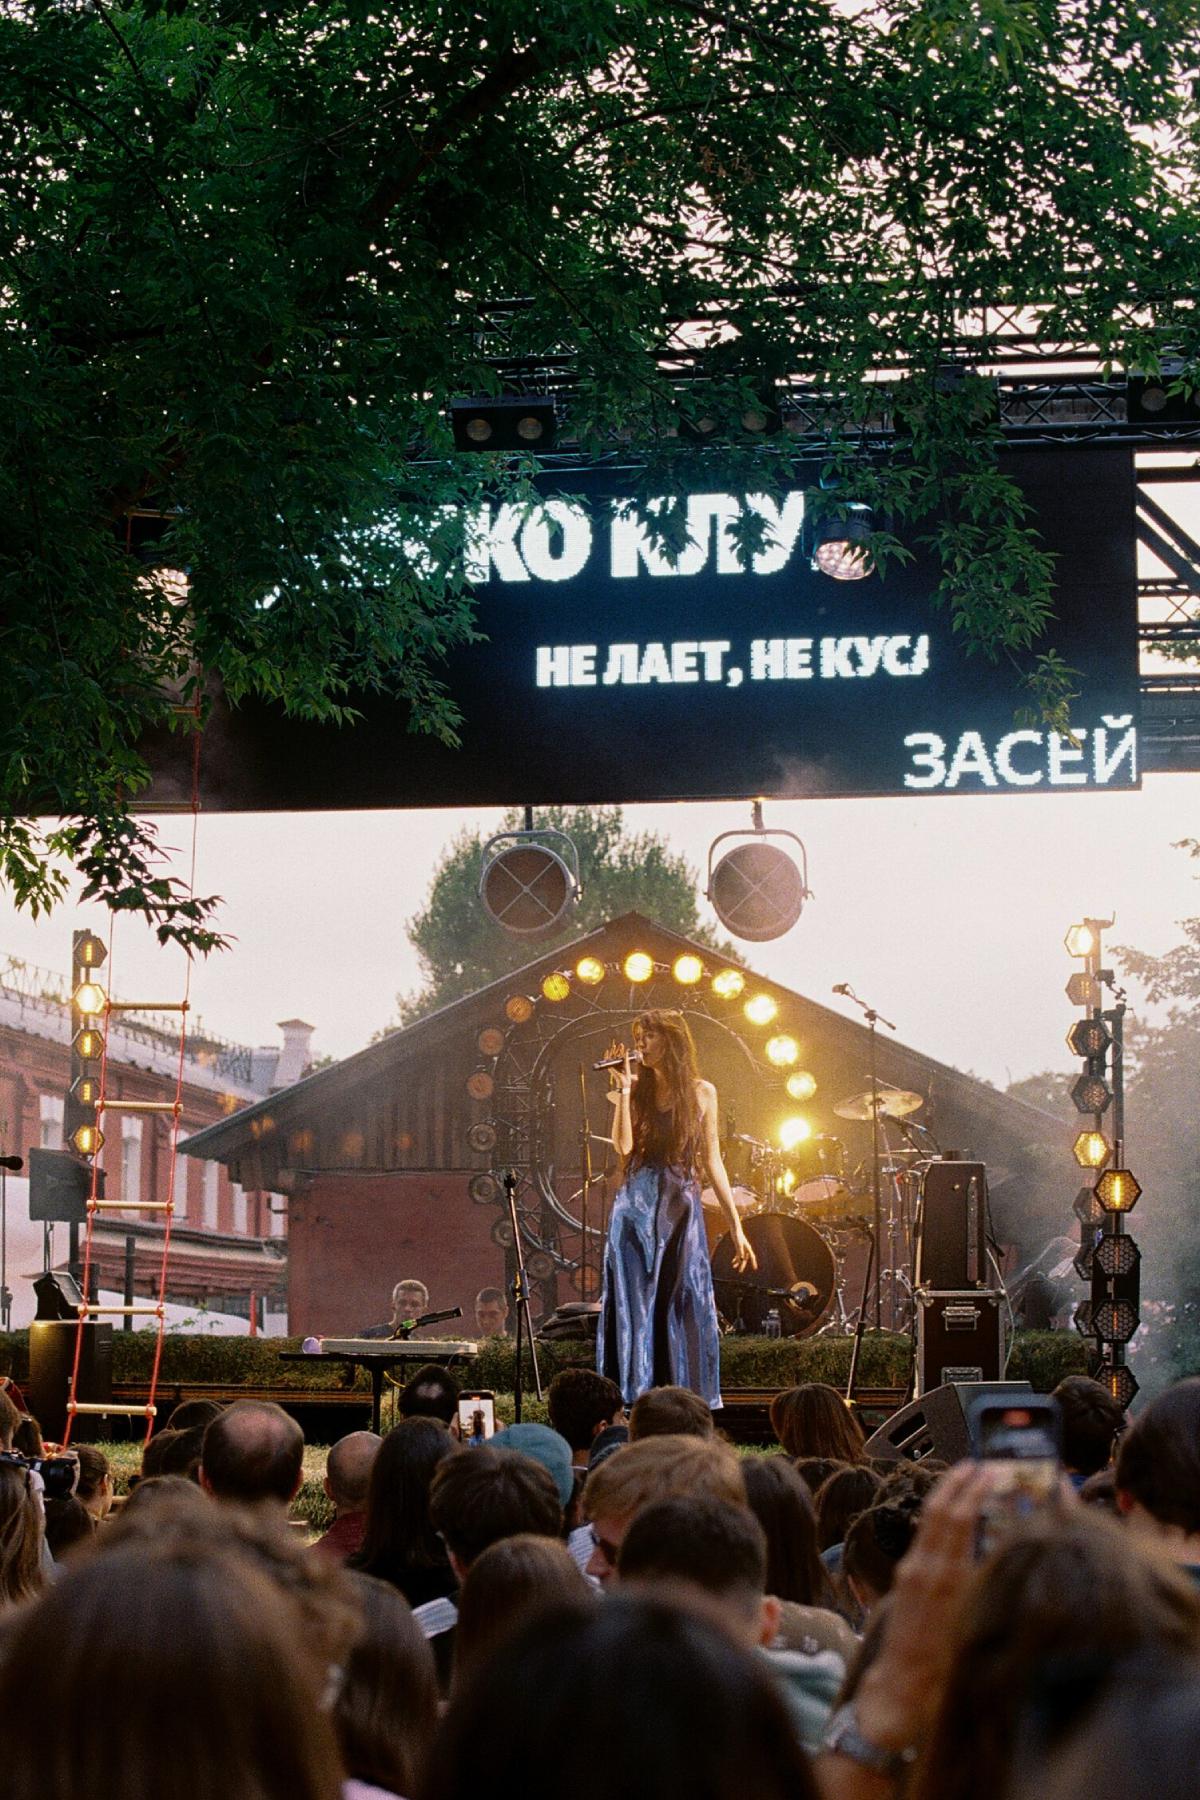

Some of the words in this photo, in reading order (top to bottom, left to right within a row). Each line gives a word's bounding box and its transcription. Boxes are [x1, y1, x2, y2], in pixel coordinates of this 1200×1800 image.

[536, 645, 597, 686] НЕ
[602, 640, 743, 687] ЛАЕТ,
[750, 638, 814, 680] НЕ
[903, 714, 1137, 788] ЗАСЕЙ
